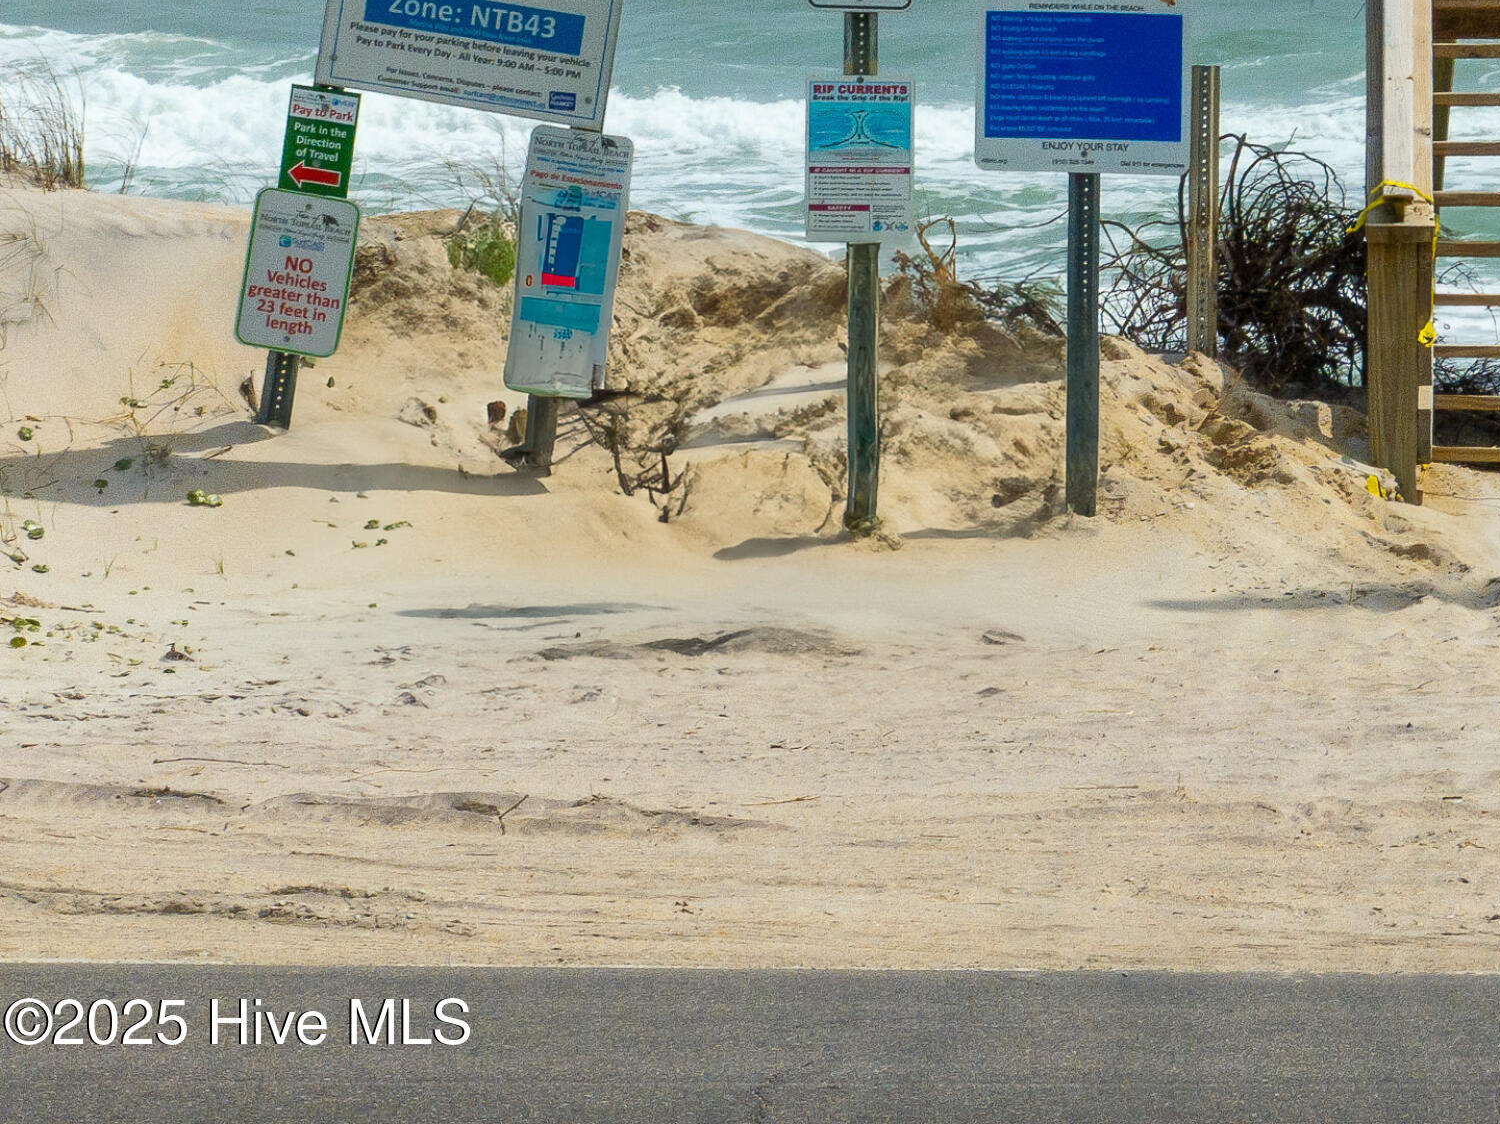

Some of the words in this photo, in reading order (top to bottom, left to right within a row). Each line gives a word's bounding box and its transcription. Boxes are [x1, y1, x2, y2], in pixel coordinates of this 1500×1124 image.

[471, 4, 556, 38] NTB43
[350, 21, 379, 34] Please
[381, 27, 399, 38] pay
[399, 29, 412, 39] for
[414, 33, 435, 43] your
[436, 36, 470, 50] parking
[472, 41, 502, 54] before
[503, 46, 536, 61] leaving
[537, 54, 557, 63] your
[559, 56, 591, 68] vehicle
[356, 36, 372, 47] Pay
[373, 38, 383, 47] to
[385, 40, 405, 52] Park
[407, 43, 432, 56] Every
[434, 48, 452, 60] Day
[458, 52, 471, 62] All
[518, 63, 535, 72] AM
[565, 69, 581, 79] PM
[813, 84, 834, 94] RIP
[838, 84, 908, 95] CURRENTS
[293, 104, 312, 117] Pay
[315, 108, 326, 116] to
[330, 109, 353, 121] Park
[294, 122, 316, 133] Park
[319, 125, 328, 134] in
[330, 127, 347, 138] the
[296, 135, 341, 150] Direction
[1042, 141, 1074, 150] ENJOY
[1076, 142, 1104, 151] YOUR
[1106, 143, 1129, 151] STAY
[296, 148, 307, 157] of
[310, 149, 339, 162] Travel
[284, 256, 313, 274] NO
[267, 269, 327, 291] Vehicles
[248, 284, 302, 303] greater
[306, 293, 340, 309] than
[257, 299, 275, 313] 23
[279, 302, 308, 319] feet
[312, 309, 327, 322] in
[265, 315, 312, 335] length
